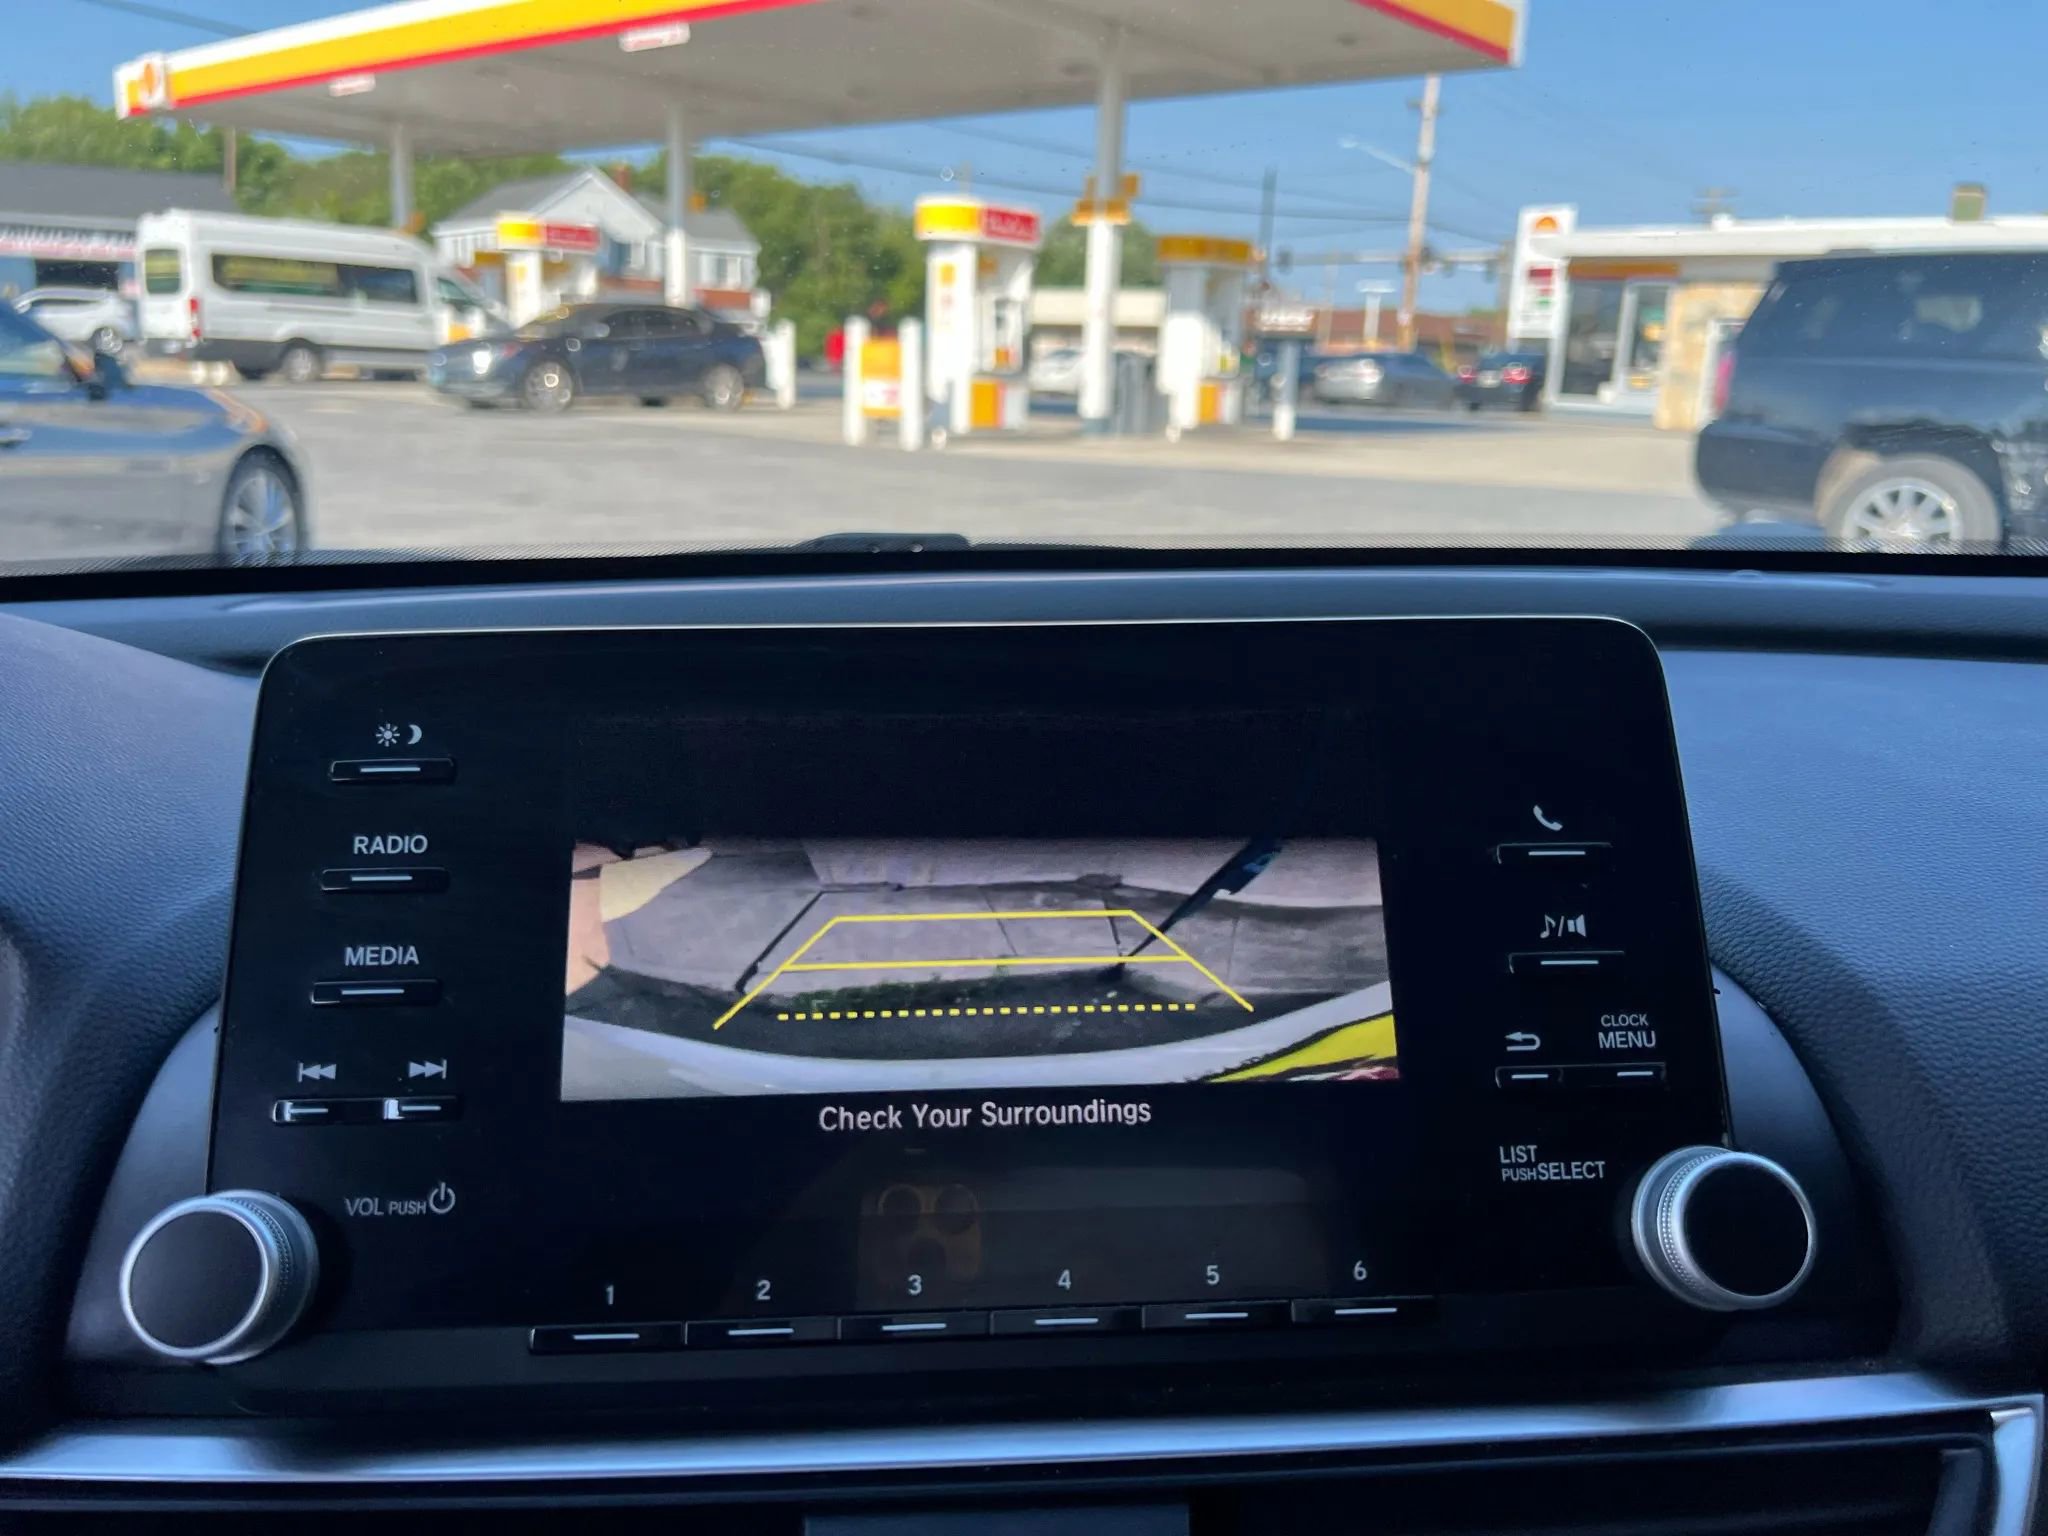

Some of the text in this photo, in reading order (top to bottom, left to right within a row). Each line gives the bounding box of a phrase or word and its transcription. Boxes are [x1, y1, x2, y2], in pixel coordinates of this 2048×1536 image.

[352, 834, 429, 855] RADIO
[343, 945, 420, 967] MEDIA
[1600, 1013, 1649, 1028] CLOCK
[1597, 1030, 1657, 1050] MENU
[818, 1098, 1152, 1132] Check Your Surroundings
[1499, 1144, 1538, 1164] LIST
[1501, 1160, 1606, 1182] PUSH SELECT
[344, 1196, 427, 1217] VOL PUSH
[1057, 1268, 1072, 1290] 4
[1205, 1264, 1221, 1286] 5
[1352, 1259, 1368, 1281] 6
[605, 1284, 615, 1306] 1
[756, 1278, 772, 1301] 2
[907, 1274, 923, 1296] 3
